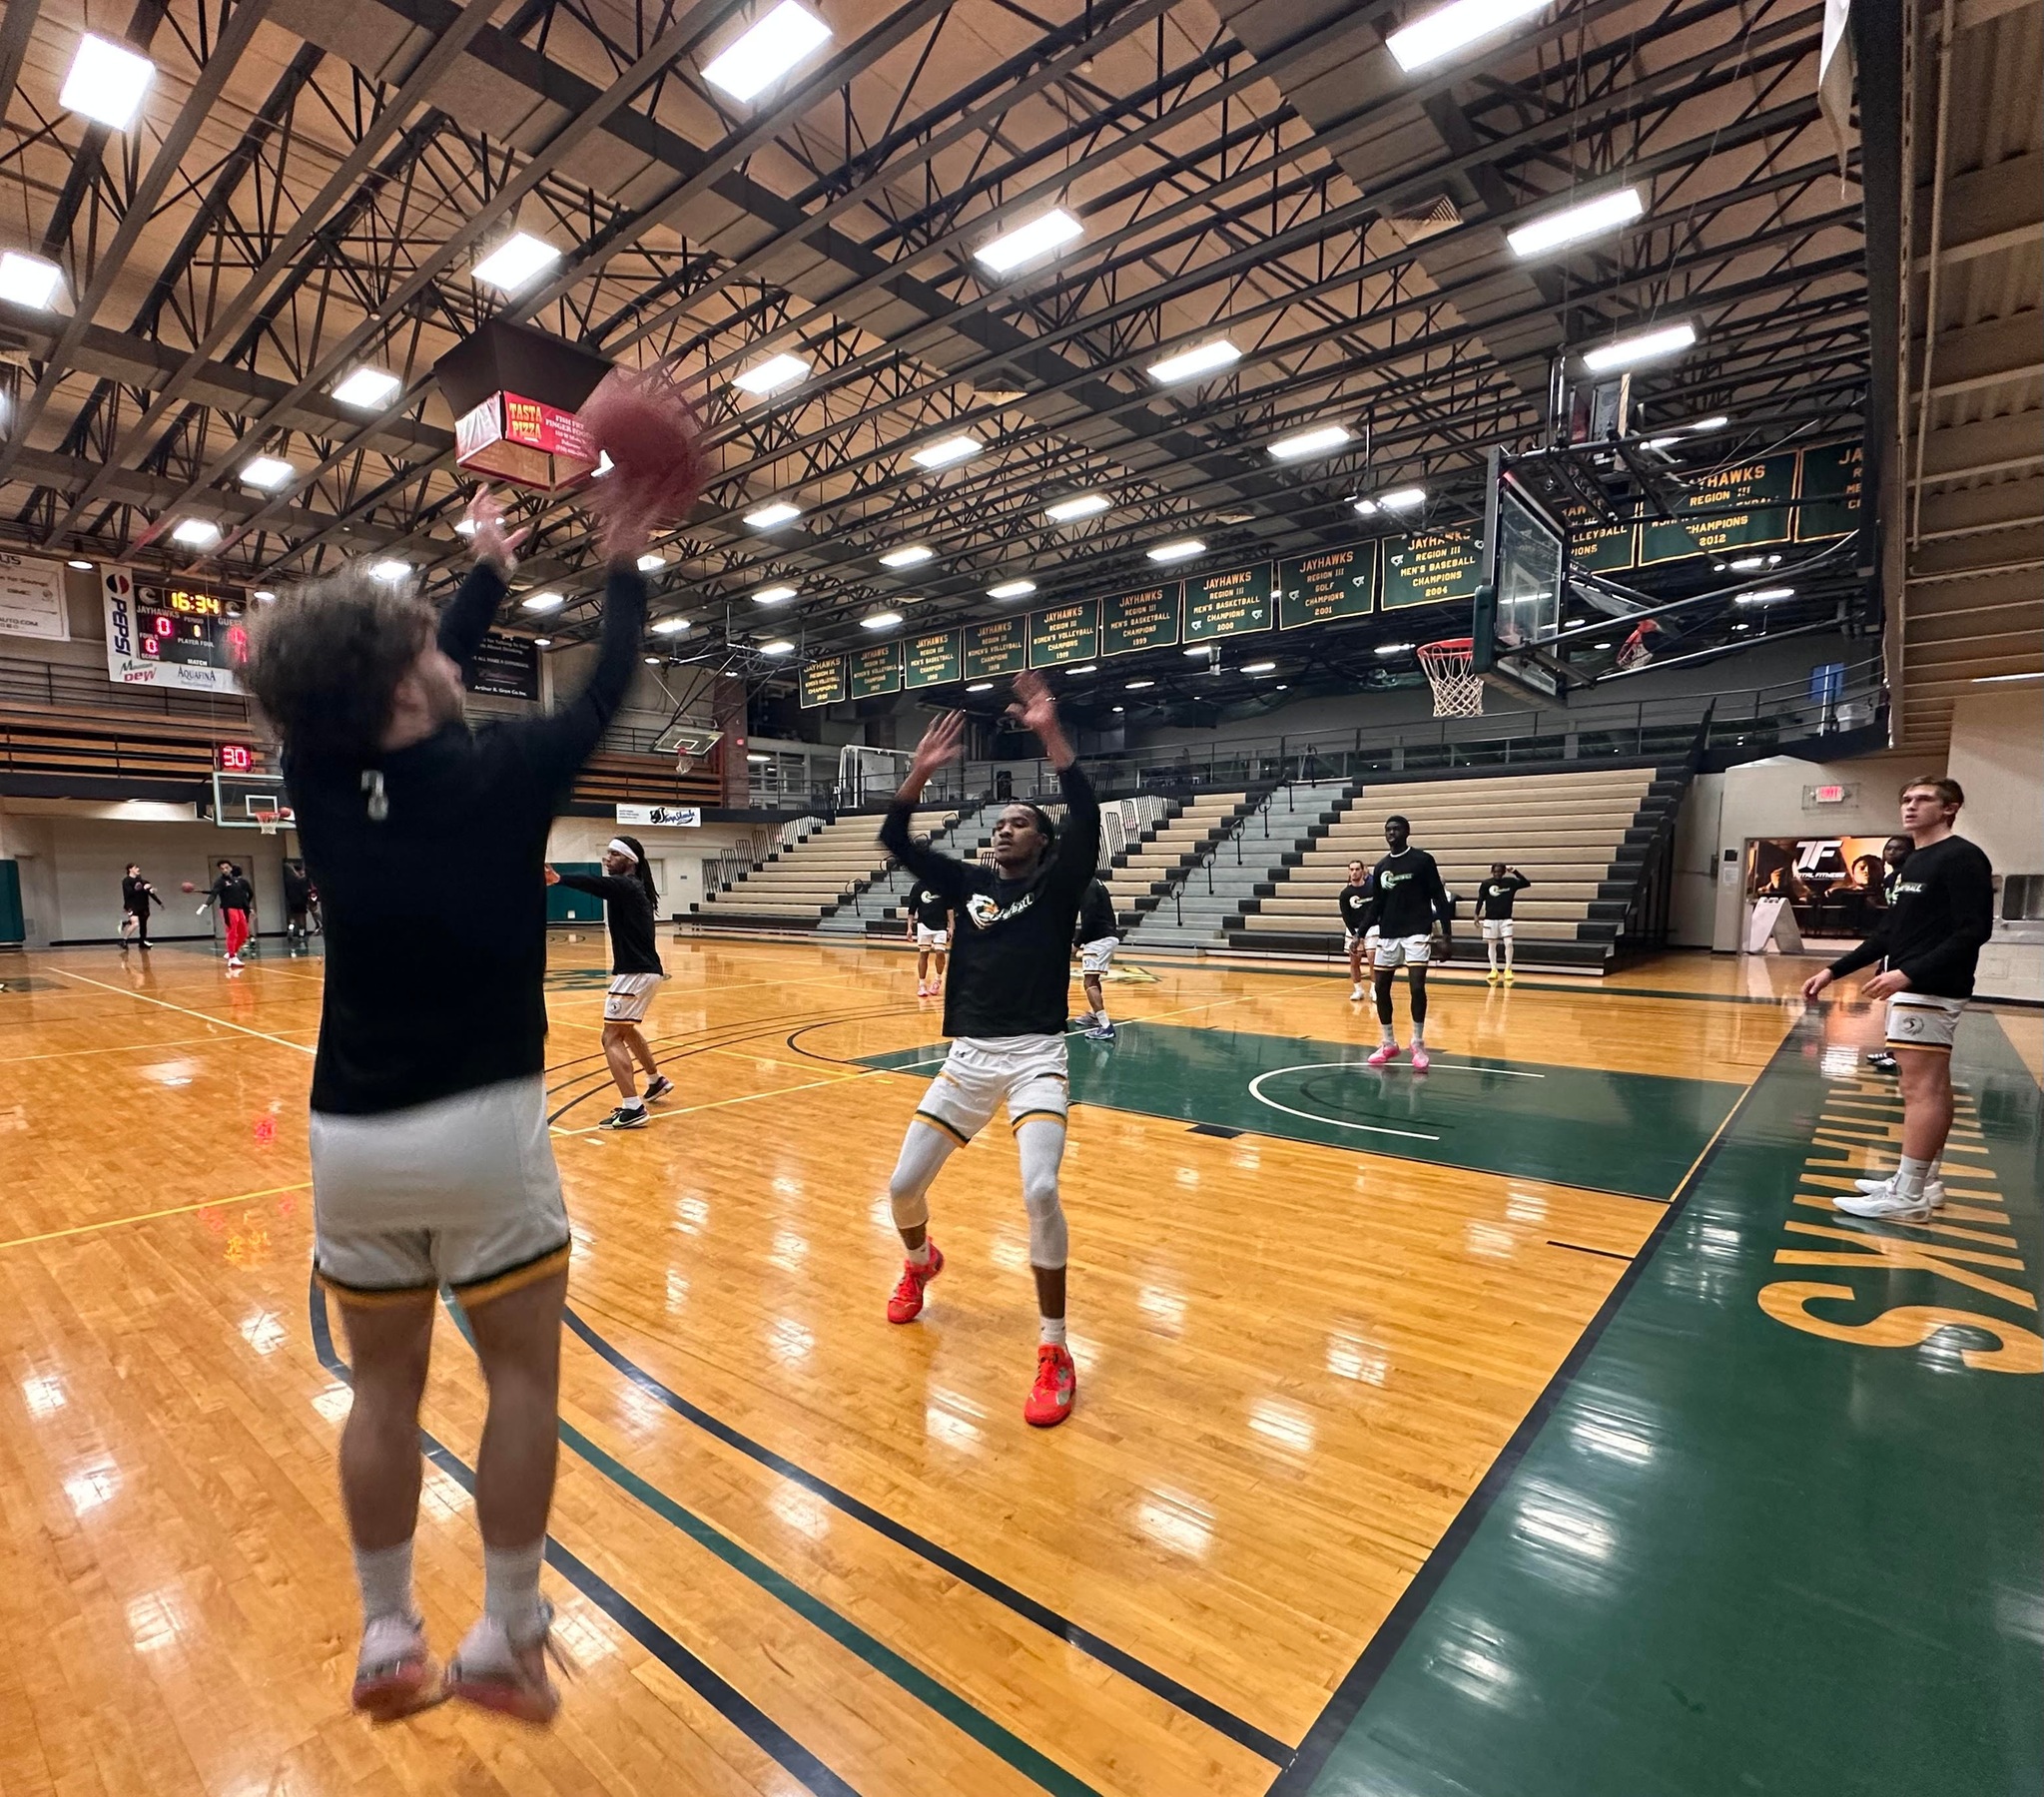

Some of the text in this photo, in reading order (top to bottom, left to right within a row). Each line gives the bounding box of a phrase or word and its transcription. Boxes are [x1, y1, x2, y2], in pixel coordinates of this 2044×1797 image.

[509, 402, 542, 422] TASTA
[511, 420, 542, 439] PIZZA
[1690, 490, 1731, 507] REGION
[1573, 525, 1628, 543] LLEYBALL
[1699, 533, 1726, 547] 2012
[1415, 545, 1461, 562] REGION III
[1299, 551, 1354, 573] JAYHAWKS
[1400, 555, 1476, 577] MEN'S BASEBALL
[1203, 571, 1252, 591] JAYHAWKS
[1306, 568, 1345, 583] REGION III
[1412, 570, 1463, 587] CHAMPIONS
[1209, 589, 1234, 600] REGION
[1315, 582, 1335, 592] GOLF
[172, 591, 220, 615] 16:34
[1119, 590, 1163, 607] JAYHAWKS
[1193, 596, 1260, 614] MEN'S BASKETBALL
[1305, 591, 1345, 607] CHAMPIONS
[137, 605, 180, 619] JAYHAWKS
[1043, 606, 1083, 623] JAYHAWKS
[1124, 606, 1147, 616] REGION
[1207, 609, 1245, 623] CHAMPIONS
[1314, 606, 1333, 616] 2001
[112, 597, 131, 656] PEPSI
[157, 617, 171, 636] 0
[978, 621, 1013, 637] JAYHAWKS
[1049, 622, 1068, 632] REGION
[1110, 612, 1171, 630] MEN'S BASKETBALL
[1058, 627, 1094, 640] VOLLEYBALL
[1122, 624, 1157, 638] CHAMPIONS
[178, 637, 199, 646] PLAYER
[916, 634, 949, 649] JAYHAWKS
[991, 641, 1022, 653] VOLLEYBALL
[1047, 639, 1078, 651] CHAMPIONS
[804, 657, 841, 673] JAYHAWKS
[926, 654, 954, 665] BASKETBALL
[223, 747, 247, 767] 30
[1796, 840, 1843, 871] TF
